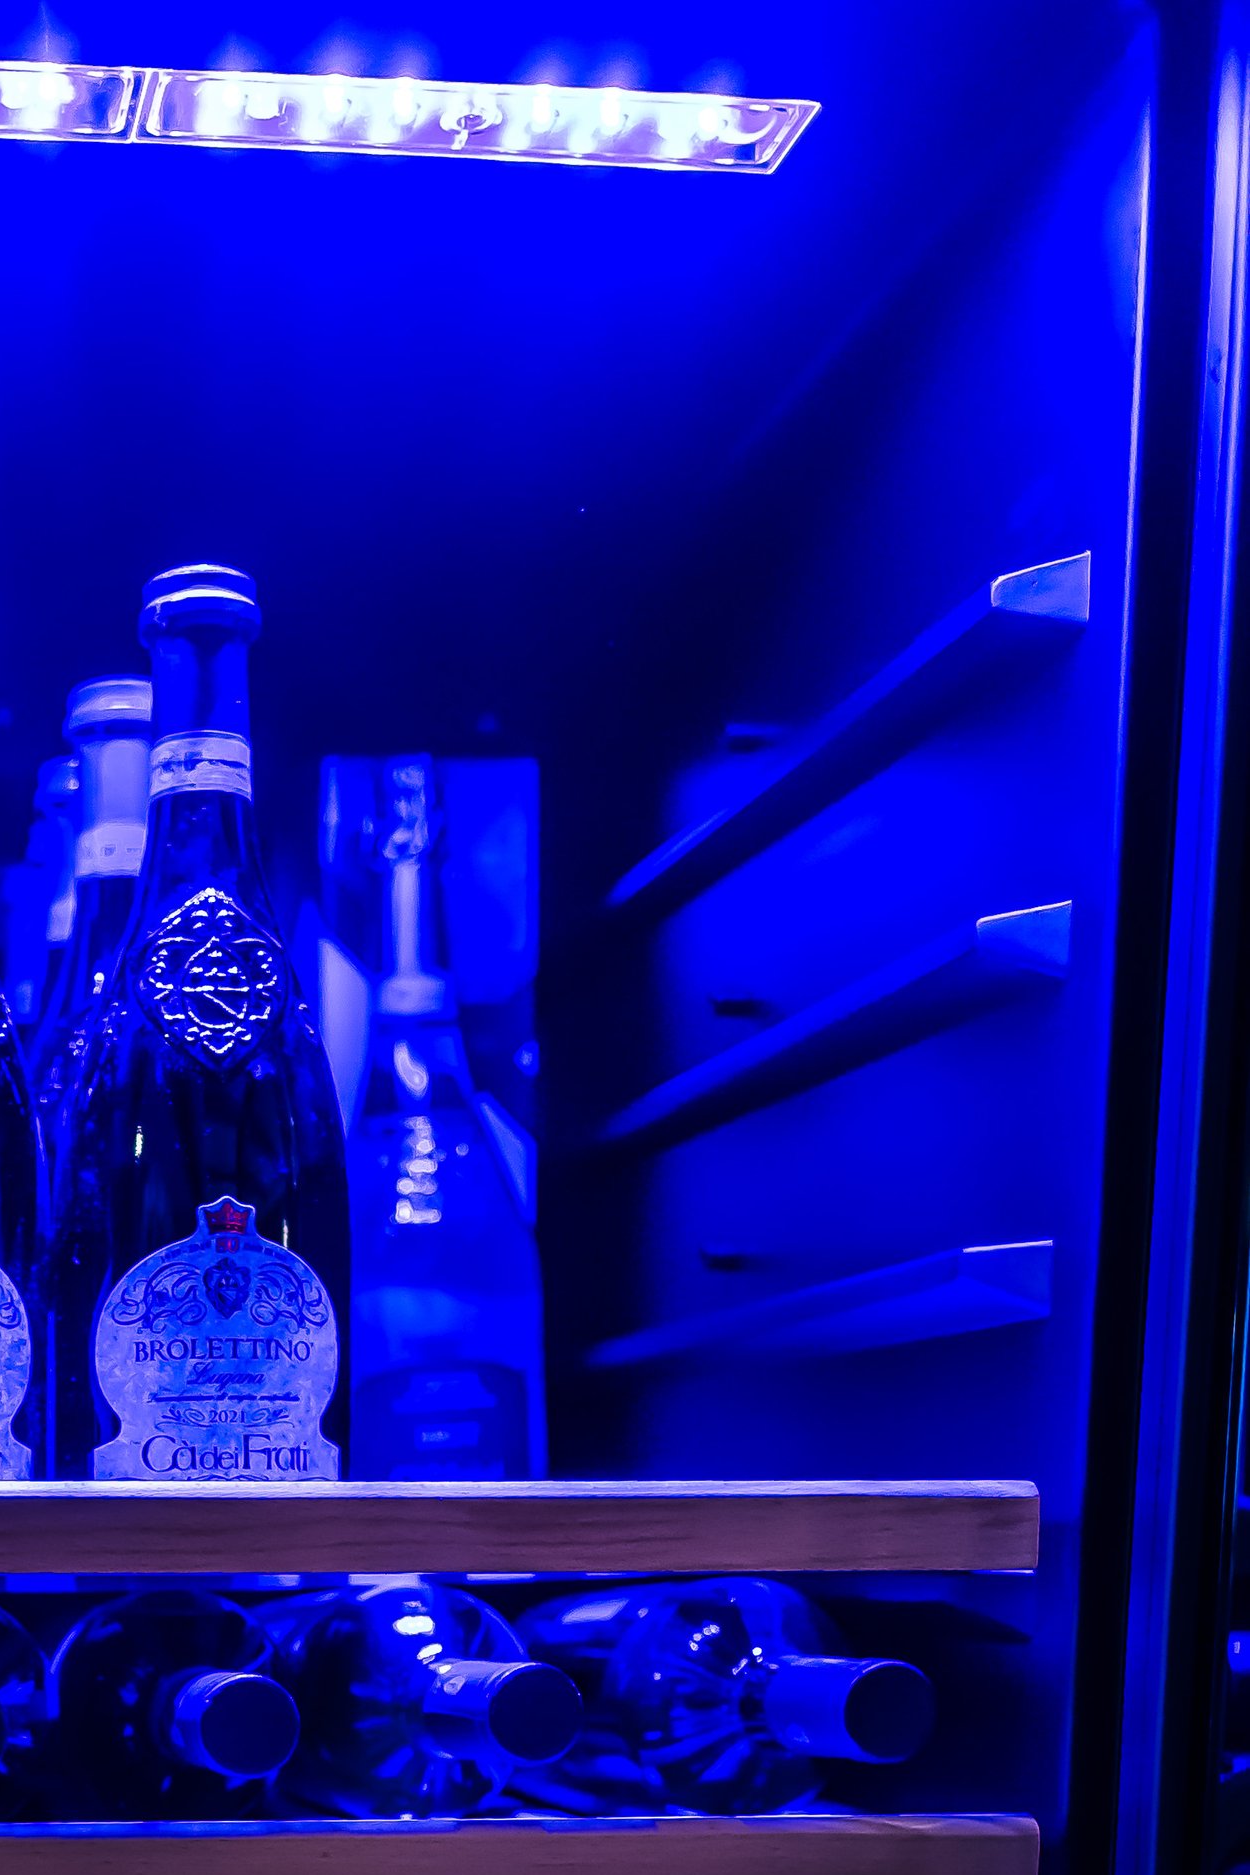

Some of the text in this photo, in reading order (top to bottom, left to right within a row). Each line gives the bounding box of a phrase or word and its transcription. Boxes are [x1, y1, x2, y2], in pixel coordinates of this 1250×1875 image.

[134, 1337, 311, 1363] BROLETTINO
[187, 1362, 266, 1391] Lugana
[209, 1409, 247, 1424] 2021
